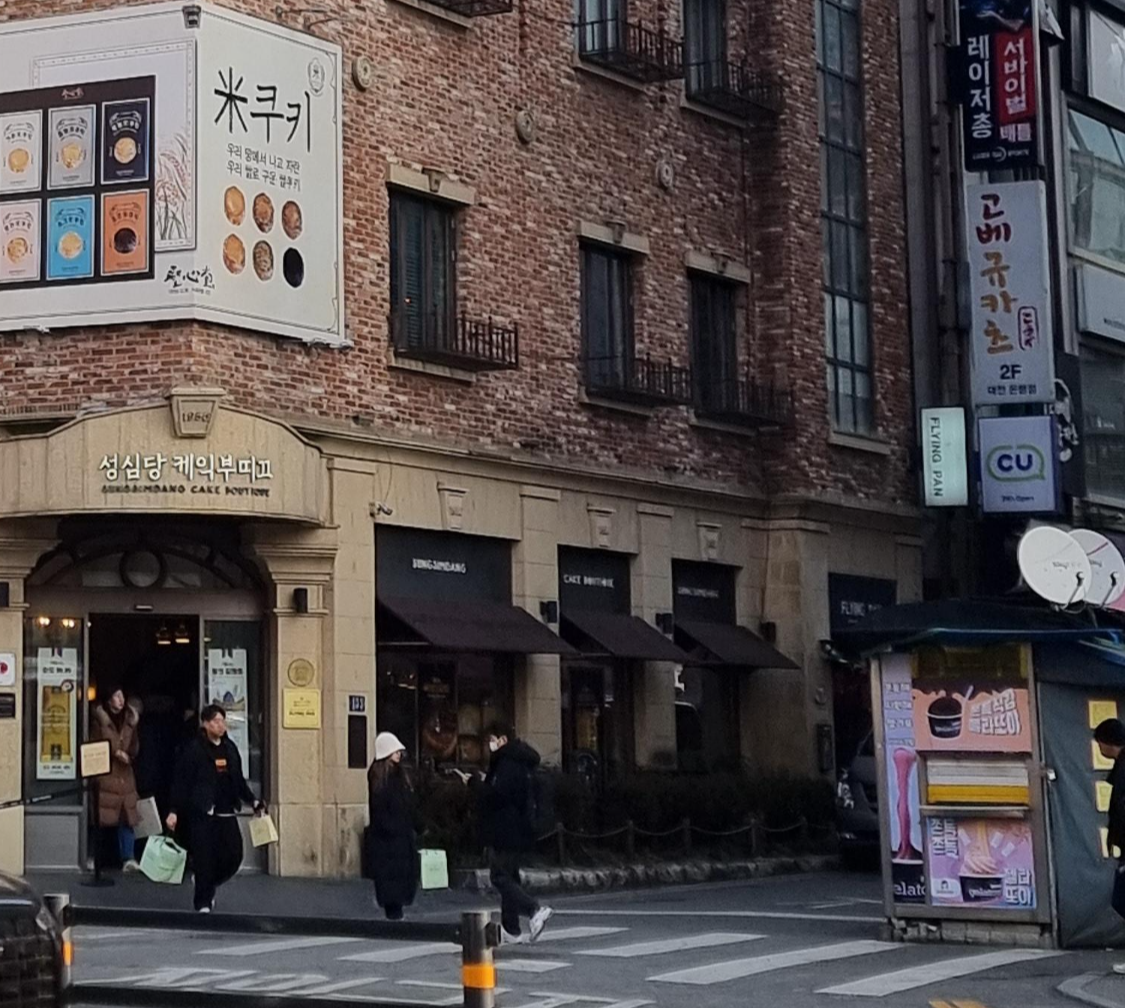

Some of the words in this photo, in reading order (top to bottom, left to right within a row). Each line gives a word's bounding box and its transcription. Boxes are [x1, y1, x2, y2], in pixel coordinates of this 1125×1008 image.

[1003, 37, 1028, 115] 서바이벌
[213, 66, 313, 154] 米쿠키
[226, 142, 242, 160] 우리
[226, 159, 242, 178] 우리
[999, 364, 1022, 380] 2F
[930, 416, 942, 464] FLYING
[99, 451, 167, 481] 성심당
[172, 452, 274, 484] 케익부띠끄
[996, 453, 1034, 473] CU
[190, 485, 221, 495] CAKE
[933, 470, 944, 497] PAN
